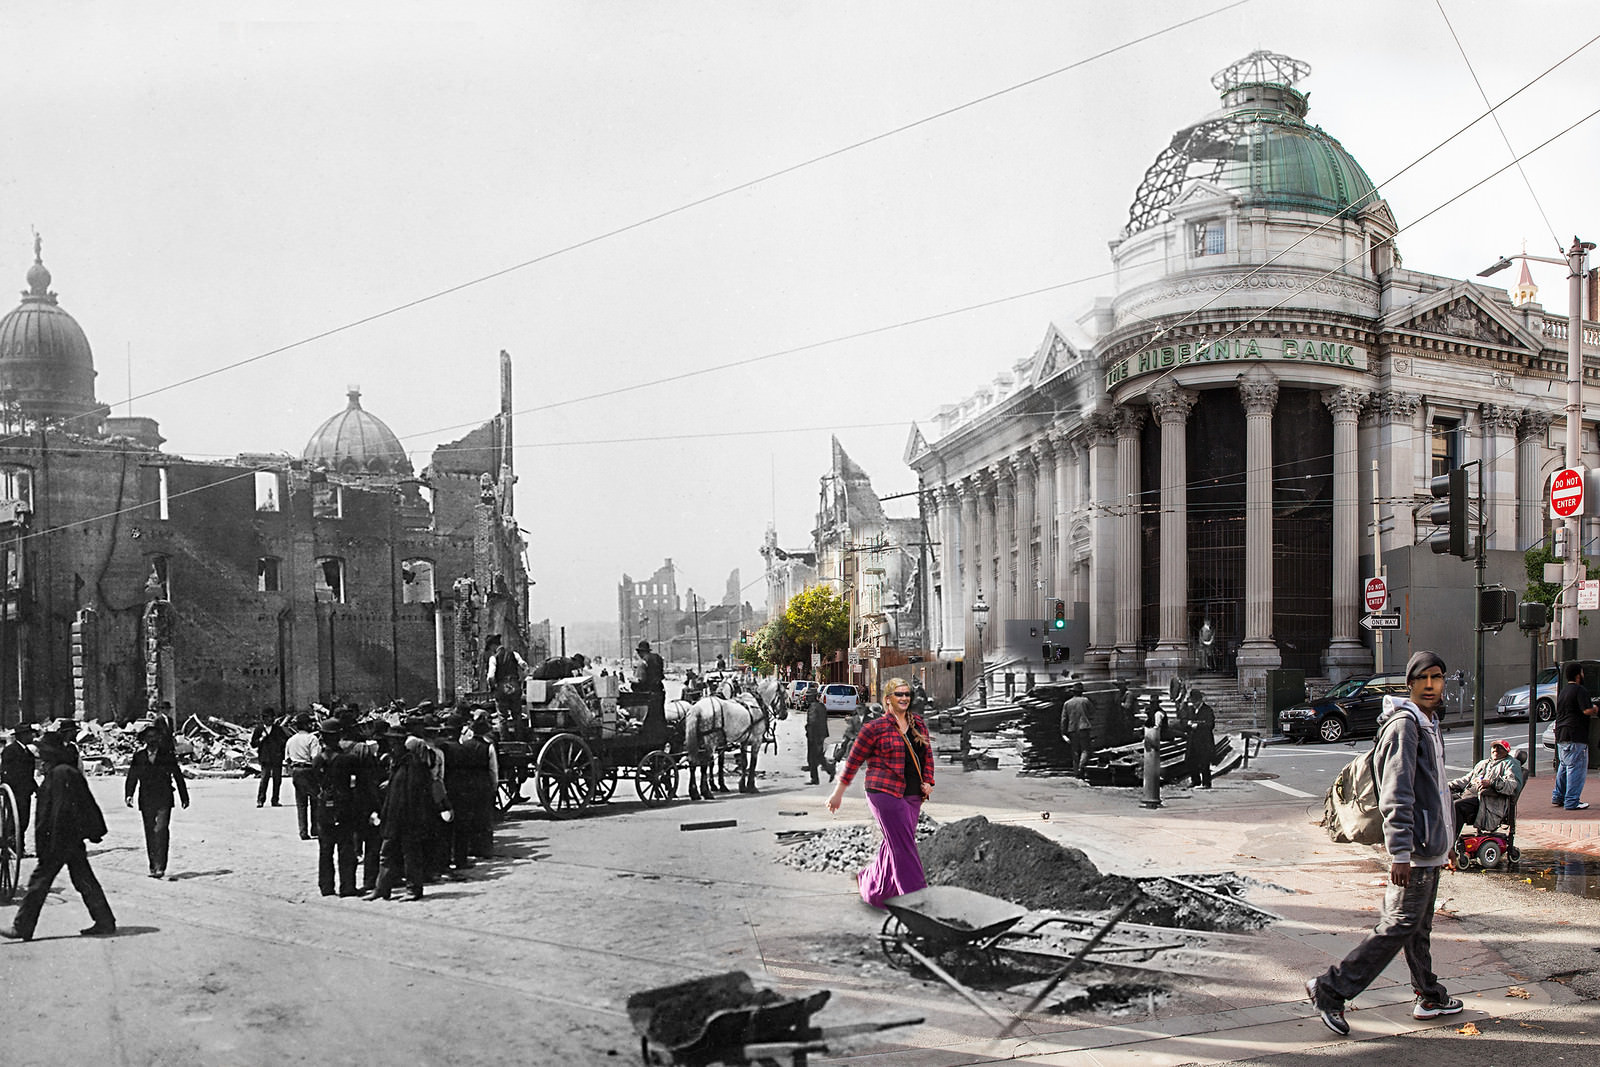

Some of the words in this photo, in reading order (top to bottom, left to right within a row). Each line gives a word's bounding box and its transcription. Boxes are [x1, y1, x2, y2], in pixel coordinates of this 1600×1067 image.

[1107, 359, 1128, 385] THE
[1138, 339, 1262, 372] HIBERNIA
[1282, 339, 1354, 366] BANK
[1555, 479, 1564, 489] DO
[1566, 476, 1579, 487] NOT
[1557, 498, 1576, 509] ENTER
